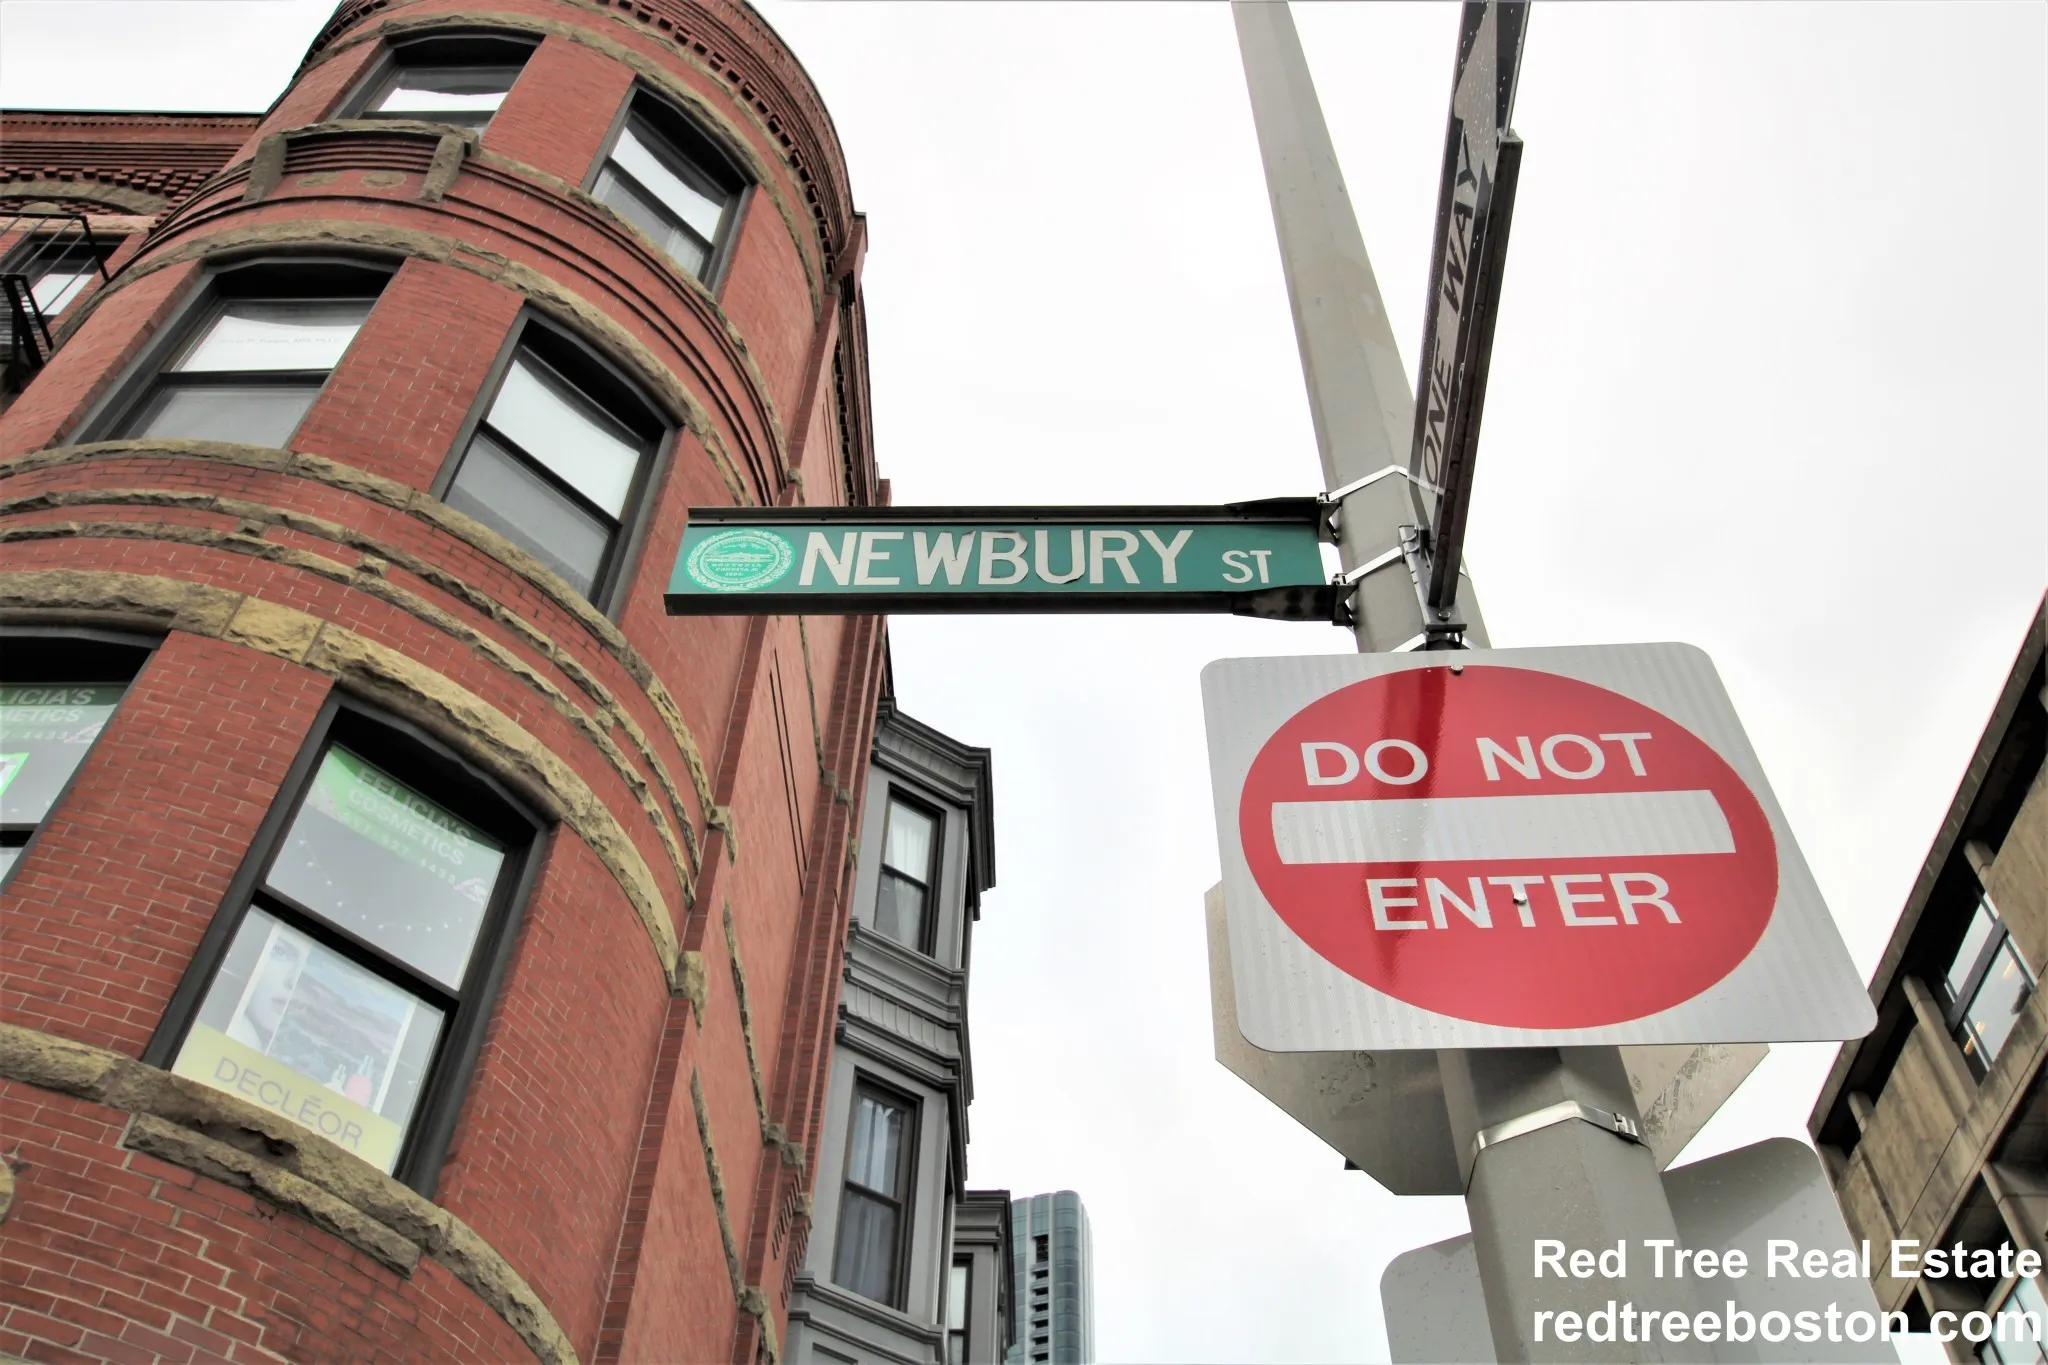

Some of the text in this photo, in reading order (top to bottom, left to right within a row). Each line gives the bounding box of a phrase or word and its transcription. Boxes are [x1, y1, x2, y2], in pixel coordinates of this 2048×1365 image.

[1423, 133, 1478, 490] ONE WAY
[798, 530, 1274, 587] NEWBURY ST
[1300, 731, 1653, 787] DO NOT
[347, 788, 465, 866] COSMETICS
[357, 766, 471, 847] FELICIA'S
[1366, 872, 1683, 932] ENTER
[213, 1057, 364, 1149] DECLÉOR
